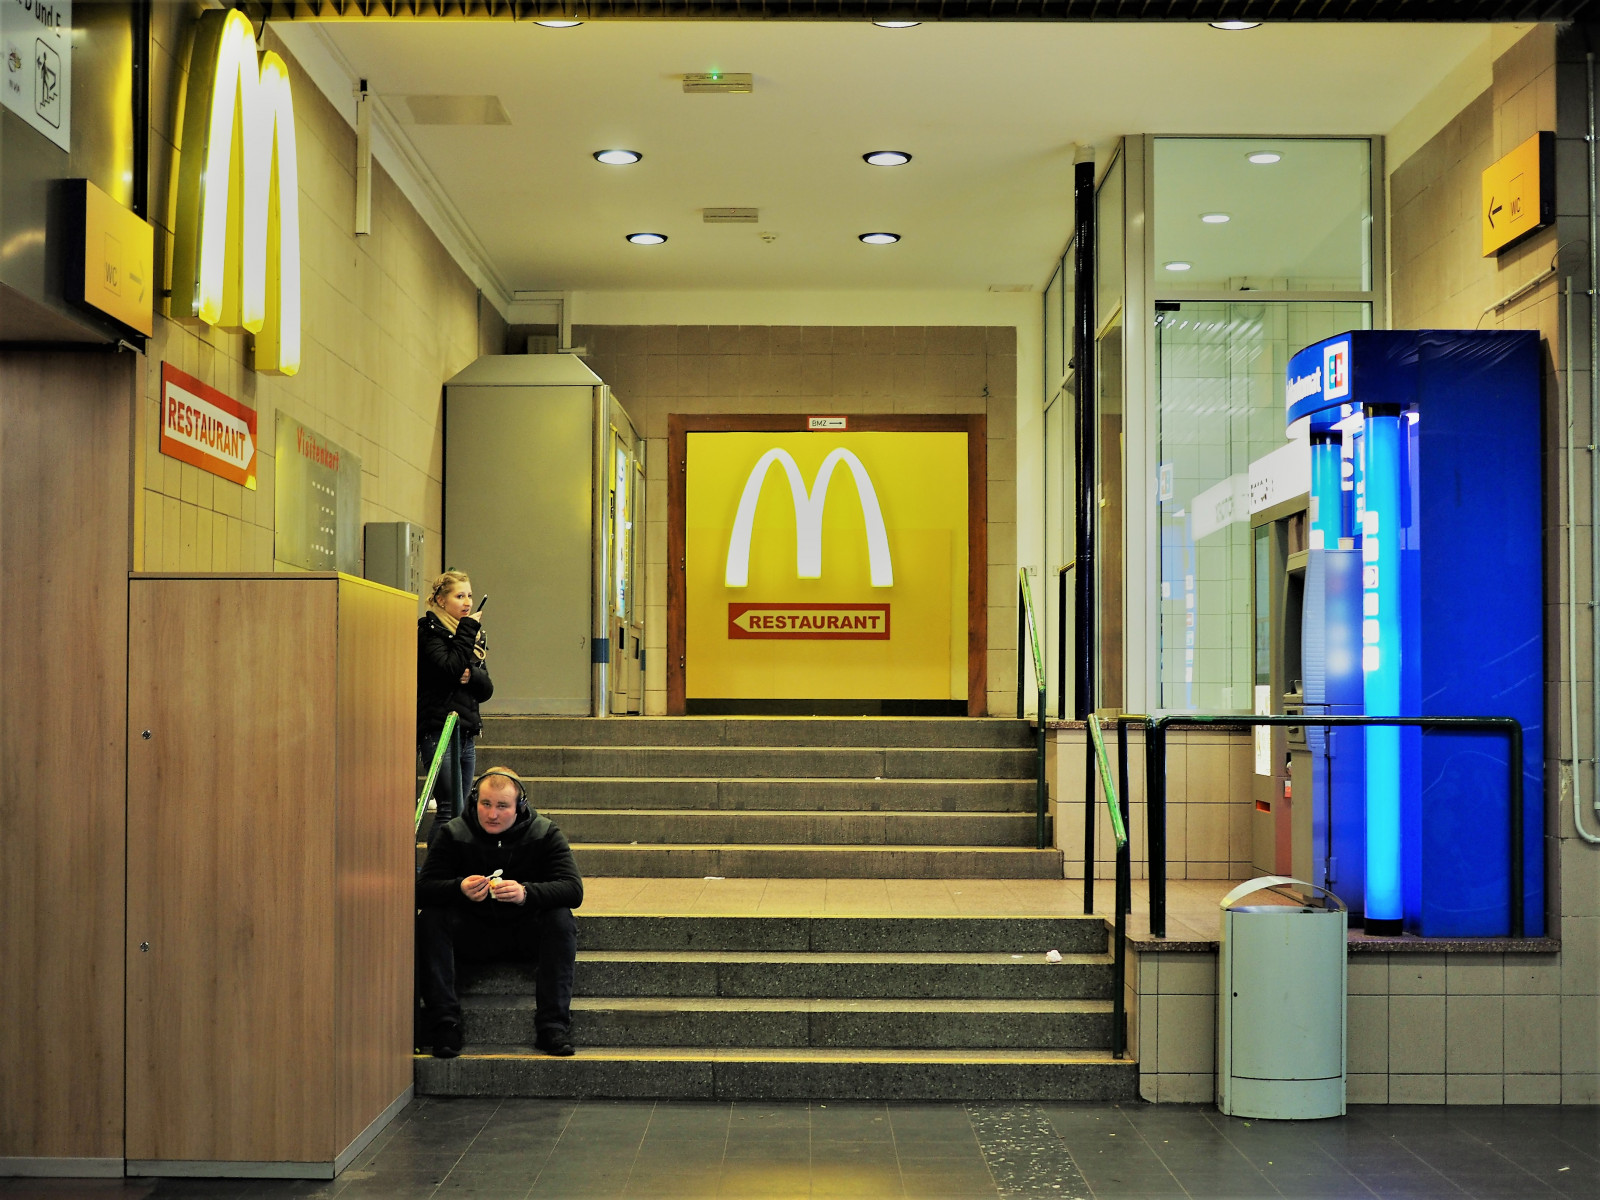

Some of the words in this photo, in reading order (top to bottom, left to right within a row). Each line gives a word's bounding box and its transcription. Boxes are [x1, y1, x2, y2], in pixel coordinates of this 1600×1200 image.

[1510, 197, 1521, 217] WC
[105, 261, 118, 287] WC
[168, 396, 246, 462] RESTAURANT
[811, 419, 827, 427] BMZ
[749, 615, 881, 630] RESTAURANT
